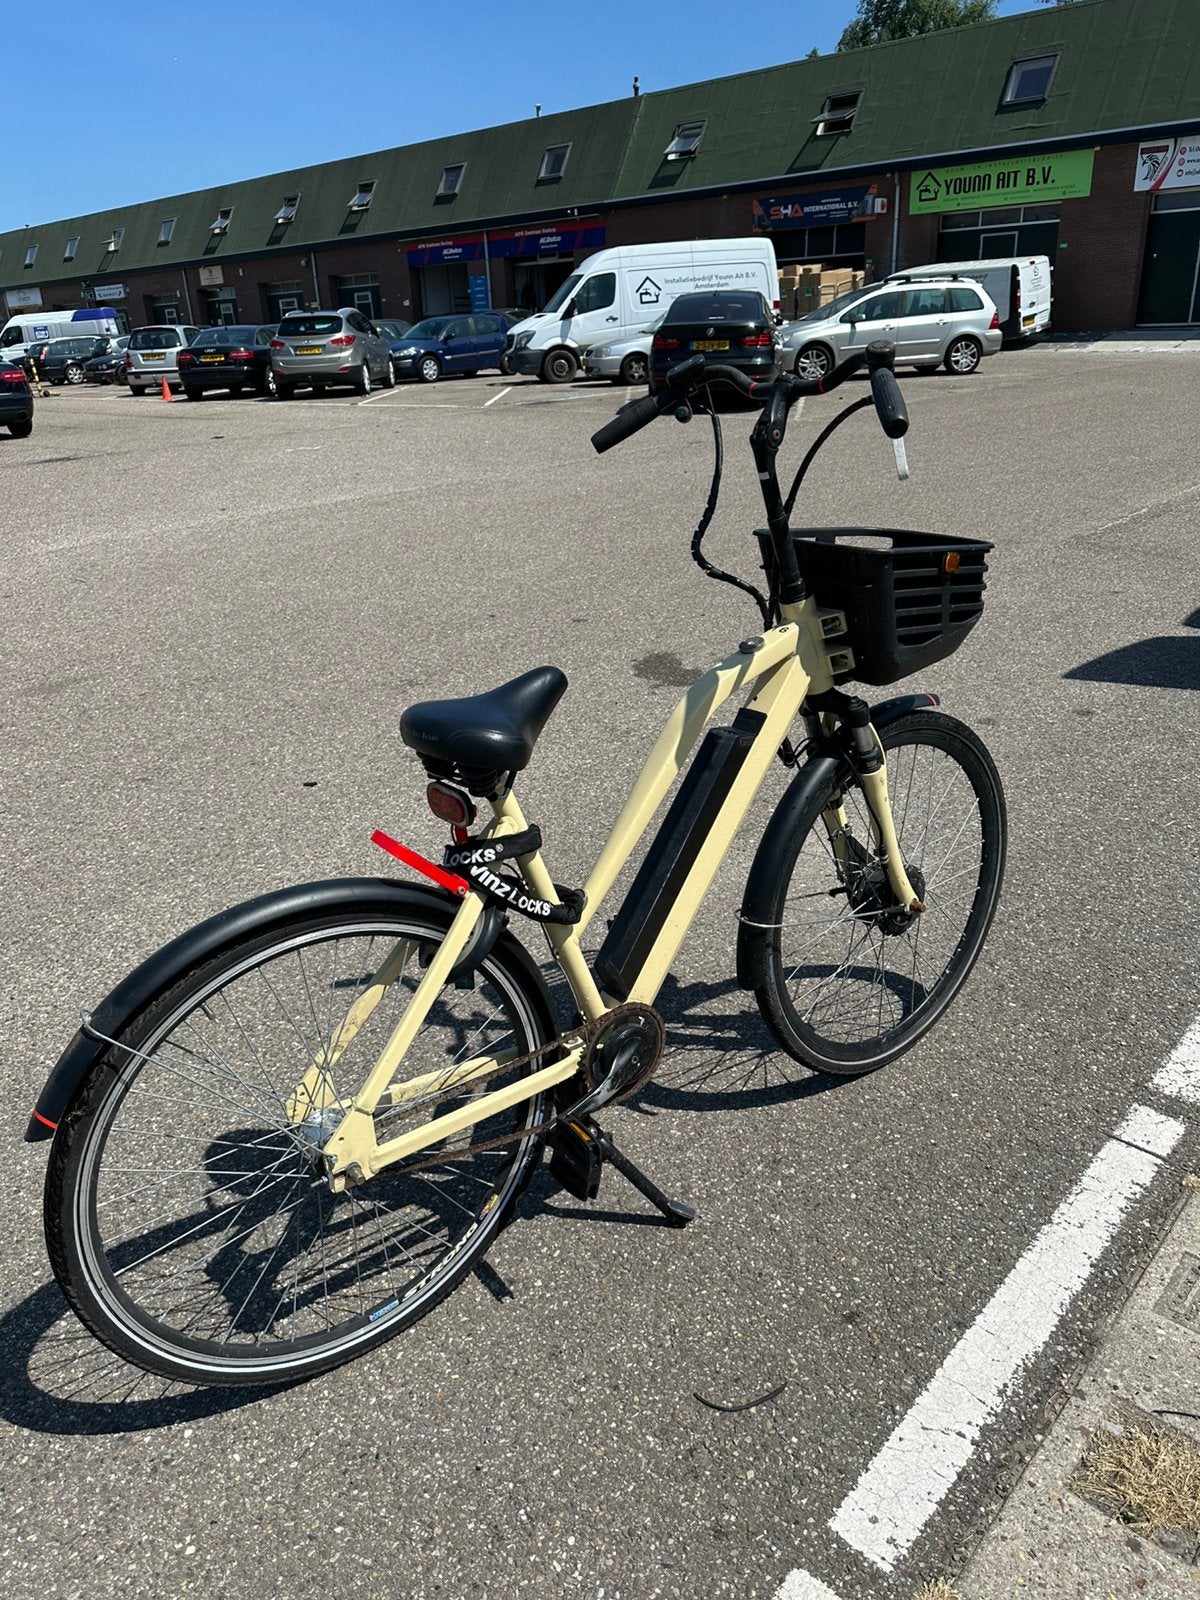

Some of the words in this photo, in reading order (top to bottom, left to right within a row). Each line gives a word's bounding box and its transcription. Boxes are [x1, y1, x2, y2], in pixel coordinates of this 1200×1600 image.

[944, 173, 992, 195] YOUNN
[996, 170, 1021, 190] AIT
[1026, 165, 1056, 186] B.V.
[769, 204, 804, 219] SHA
[803, 201, 847, 213] INTERNATIONAL
[664, 274, 714, 284] Installatiebedrijf
[714, 273, 733, 281] Younn
[507, 887, 551, 916] LOCKS
